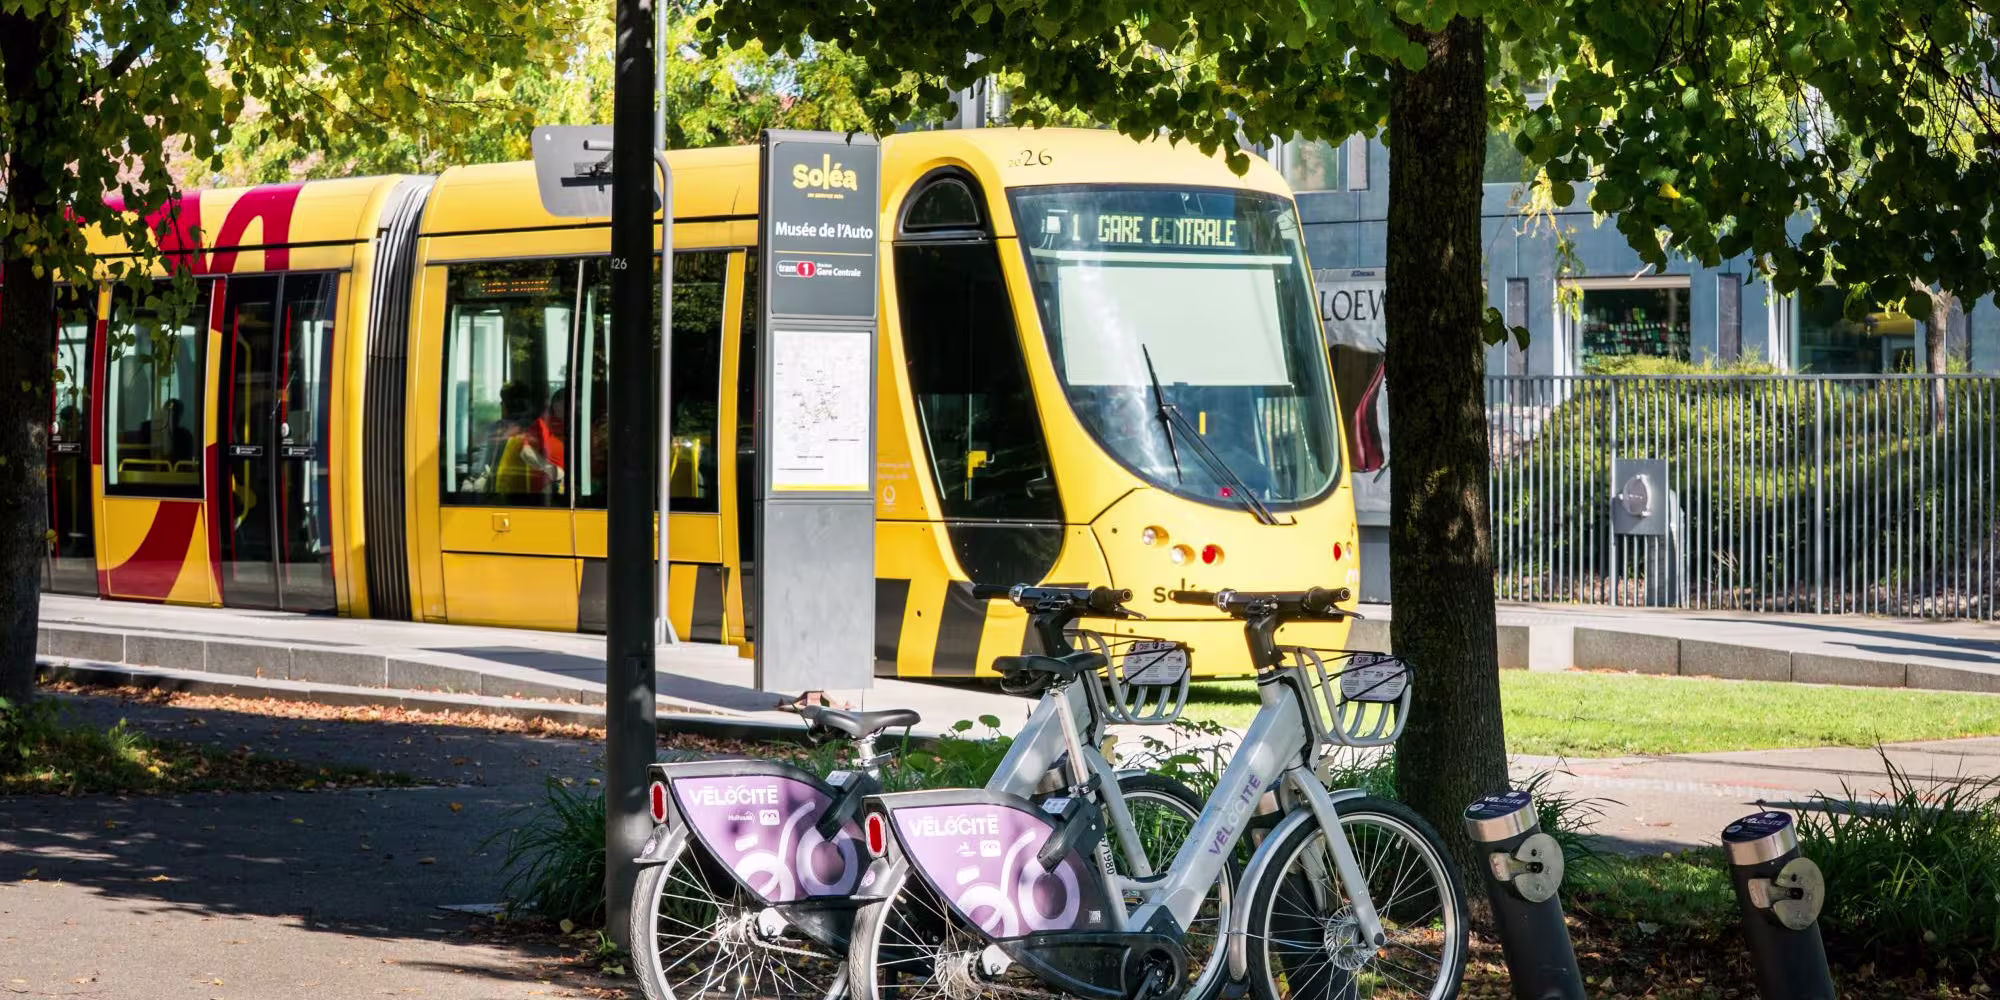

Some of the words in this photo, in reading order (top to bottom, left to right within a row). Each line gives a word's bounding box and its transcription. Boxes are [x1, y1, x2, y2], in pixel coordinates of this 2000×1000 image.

[792, 153, 858, 191] Soléa
[775, 221, 817, 237] Musée
[818, 222, 835, 238] de
[837, 223, 874, 239] l'Auto
[1072, 214, 1081, 241] 1
[1098, 214, 1144, 243] GARE
[1151, 216, 1237, 247] CENTRALE
[778, 263, 797, 273] tram
[803, 263, 809, 275] 1
[816, 267, 833, 276] Gare
[833, 268, 862, 277] Centrale
[1320, 288, 1386, 321] LOEW
